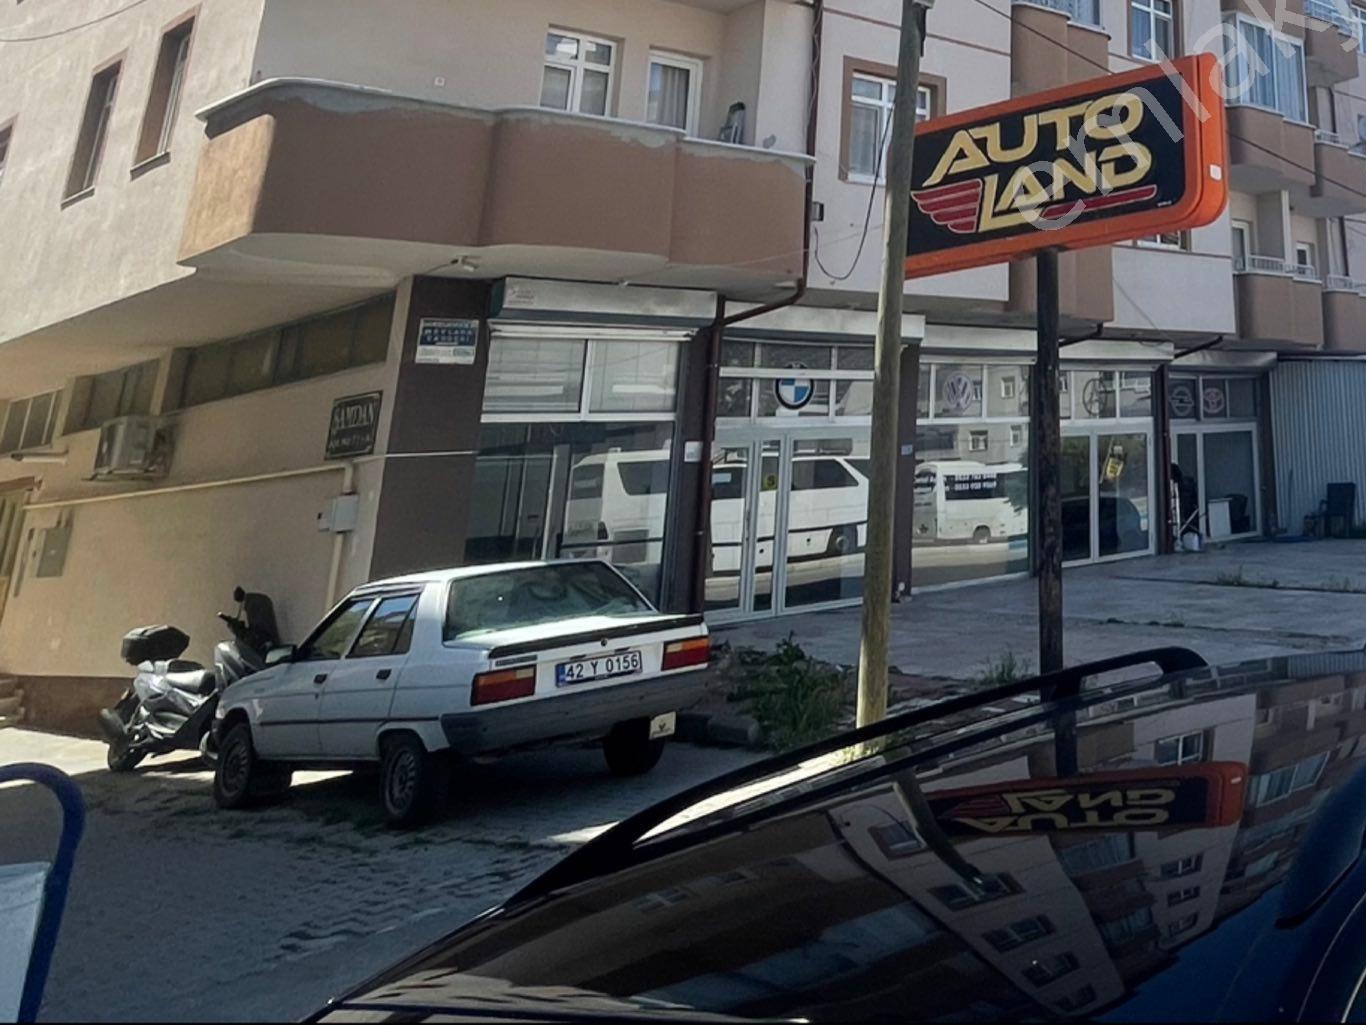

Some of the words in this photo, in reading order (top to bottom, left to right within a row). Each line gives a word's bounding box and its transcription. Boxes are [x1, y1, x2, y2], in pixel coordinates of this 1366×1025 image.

[921, 92, 1144, 187] AUTO
[976, 141, 1152, 233] LAND
[566, 663, 584, 679] 42
[590, 660, 599, 675] Y
[605, 654, 639, 673] 0156
